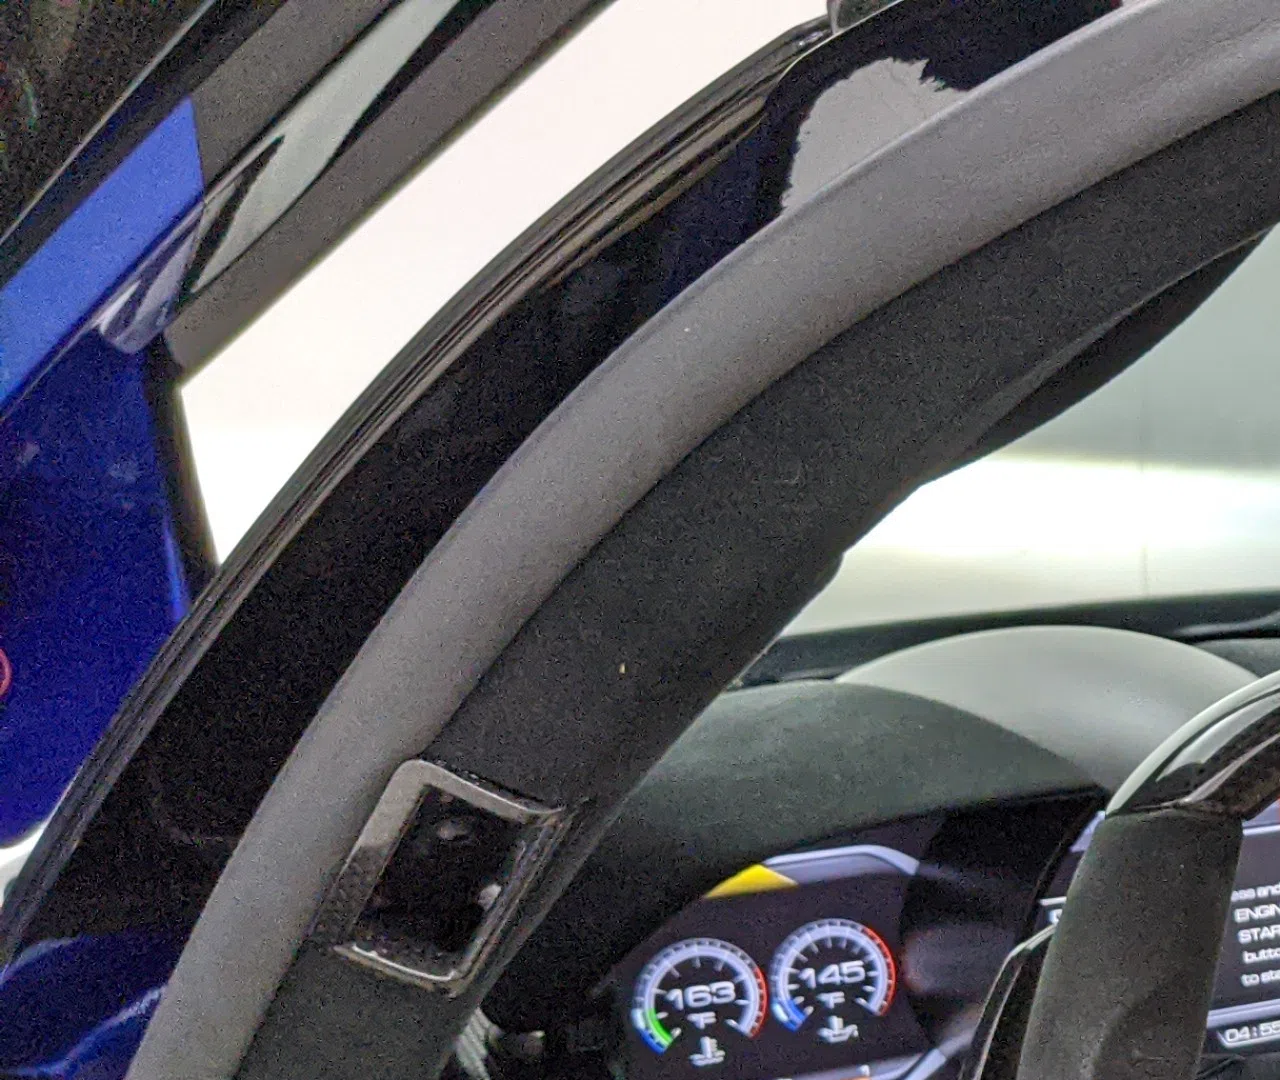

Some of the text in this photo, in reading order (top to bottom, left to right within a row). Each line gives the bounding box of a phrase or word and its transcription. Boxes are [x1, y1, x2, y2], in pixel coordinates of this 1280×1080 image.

[1231, 888, 1256, 902] ess
[799, 960, 865, 989] 145
[1241, 973, 1260, 987] to
[665, 981, 736, 1010] 163
